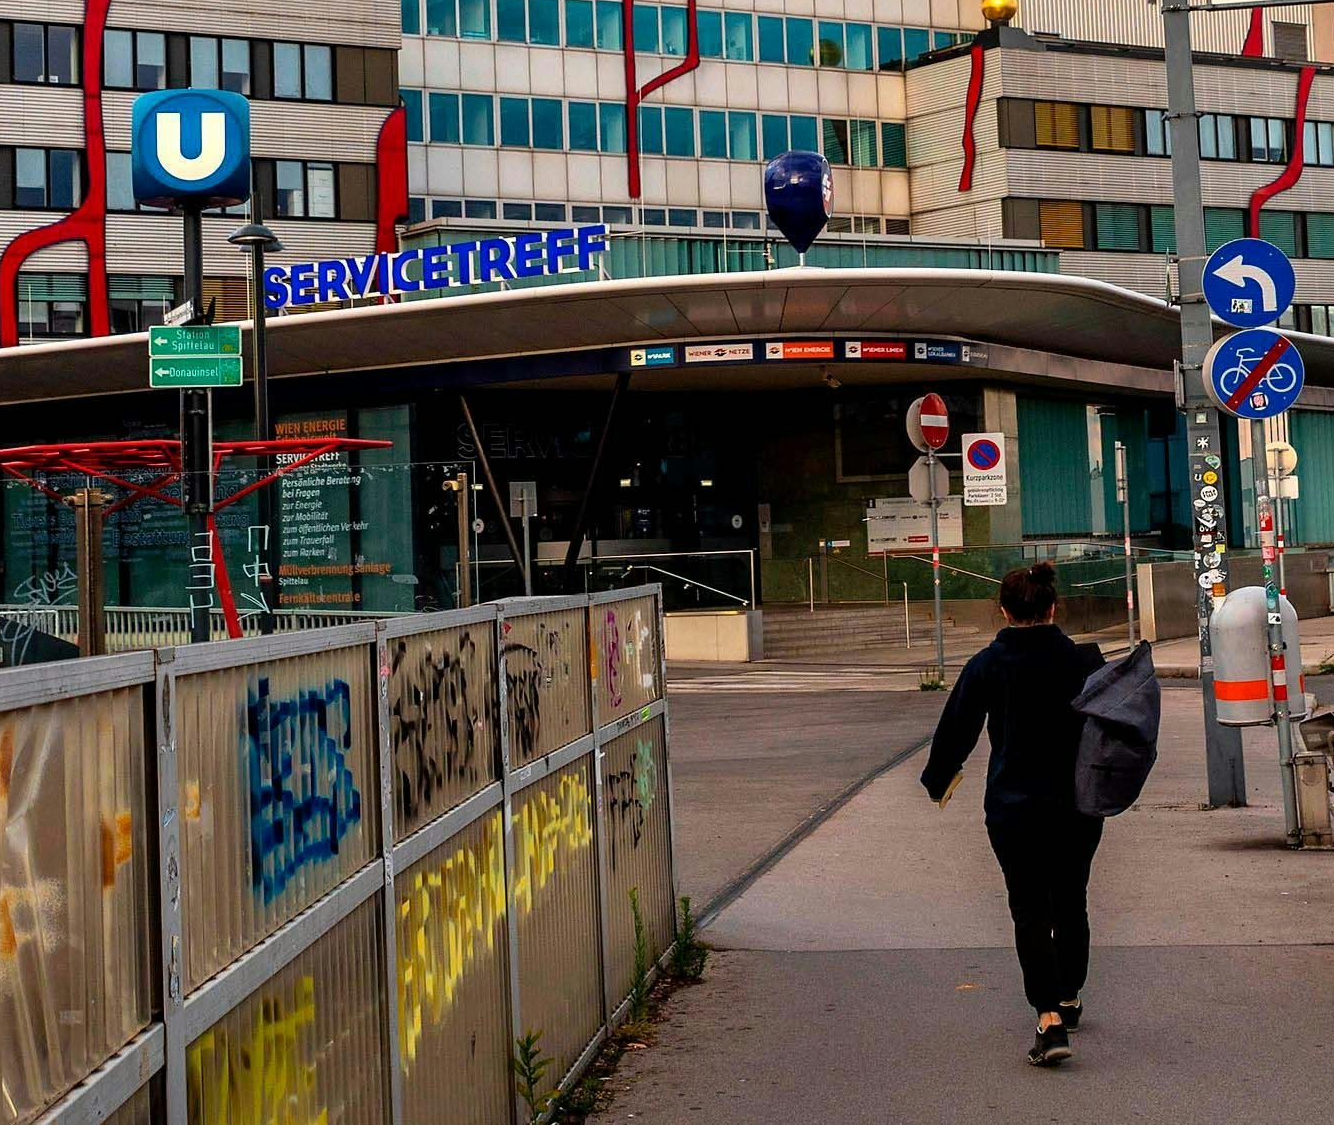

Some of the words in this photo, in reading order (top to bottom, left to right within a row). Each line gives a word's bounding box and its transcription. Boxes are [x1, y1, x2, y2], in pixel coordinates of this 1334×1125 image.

[155, 112, 226, 182] U
[264, 224, 611, 310] SERVICETREFF
[176, 329, 210, 340] Station
[171, 340, 215, 352] Spittelau
[169, 366, 219, 377] Donauinsel
[275, 422, 301, 435] WIEN
[303, 418, 347, 433] ENERGIE
[282, 476, 326, 488] Persönliche
[282, 489, 294, 498] bei
[295, 489, 321, 500] Fragen
[295, 500, 323, 511] Energie
[295, 512, 329, 522] Mobilität
[282, 526, 298, 534] zum
[282, 538, 298, 546] zum
[299, 535, 335, 546] Trauerfall
[283, 550, 299, 558] zum
[278, 563, 391, 576] Müllverbrennungsanlage
[278, 577, 309, 587] Spittelau
